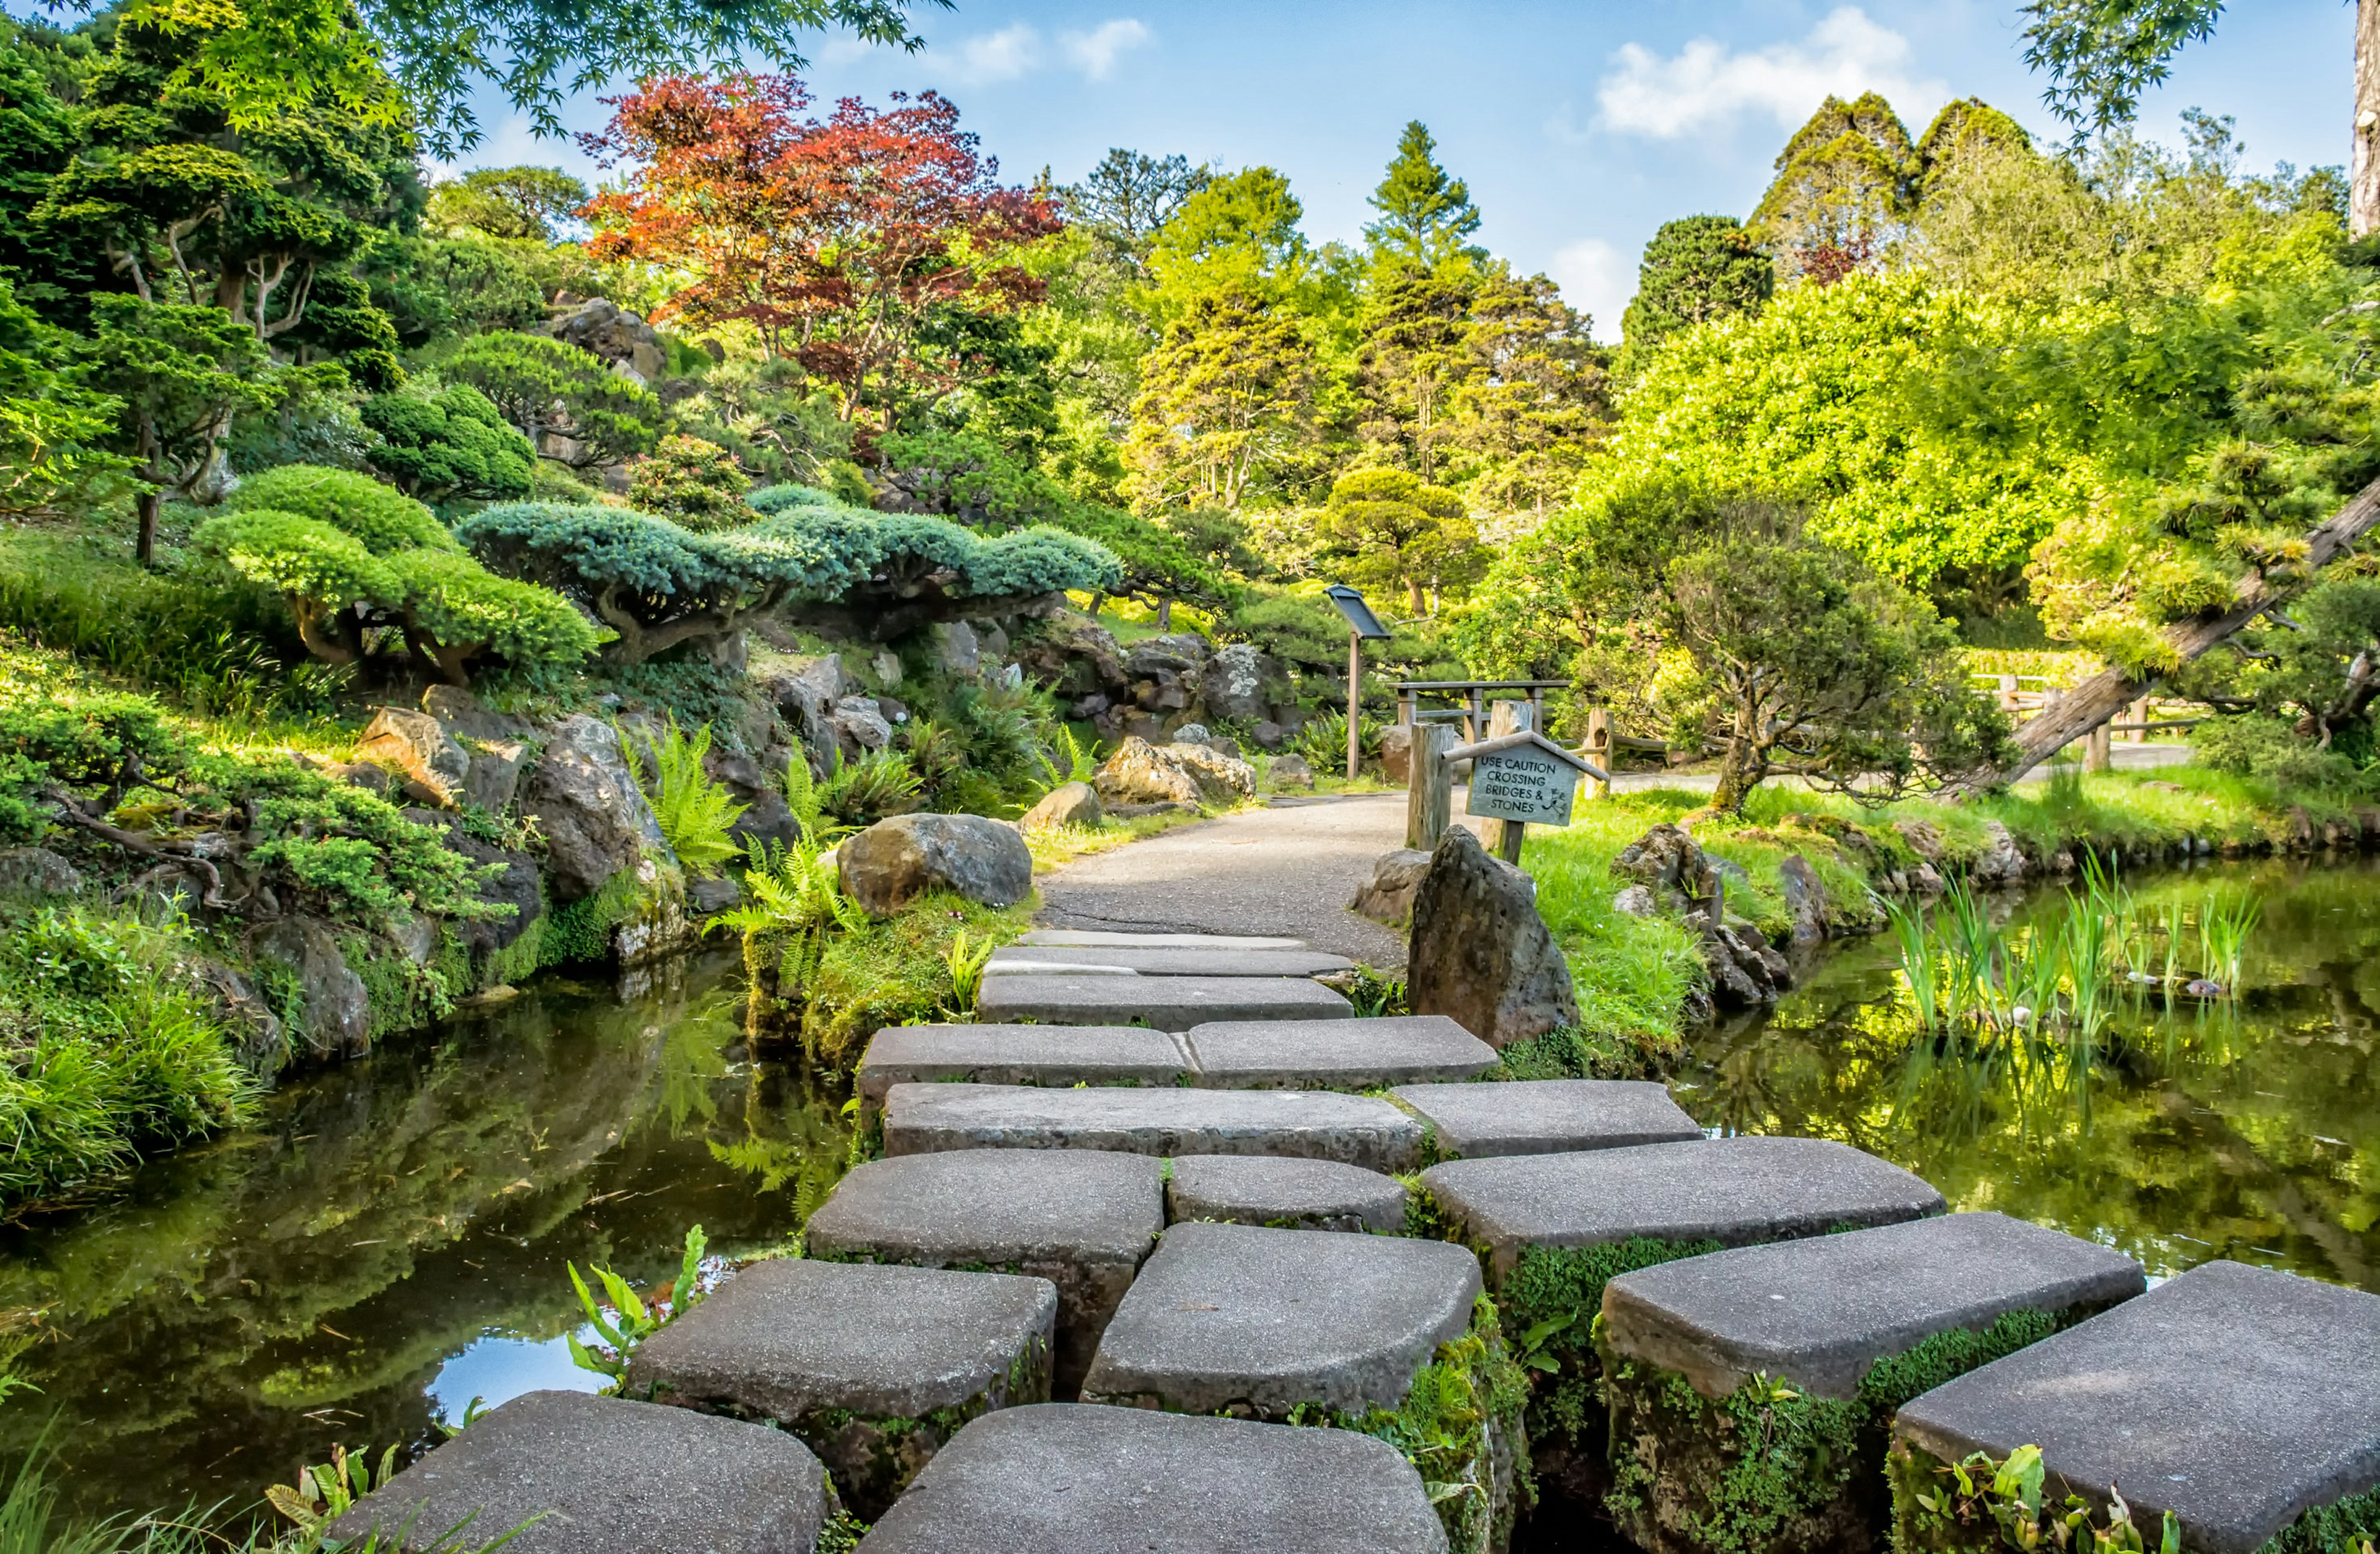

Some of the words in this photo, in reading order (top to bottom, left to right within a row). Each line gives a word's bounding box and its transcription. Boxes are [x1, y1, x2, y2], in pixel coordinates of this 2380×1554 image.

[1481, 757, 1502, 767] USE
[1505, 759, 1556, 774] CAUTION
[1488, 771, 1546, 786] CROSSING
[1486, 784, 1532, 799] BRIDGES
[1535, 790, 1543, 801] &
[1491, 799, 1534, 813] STONES
